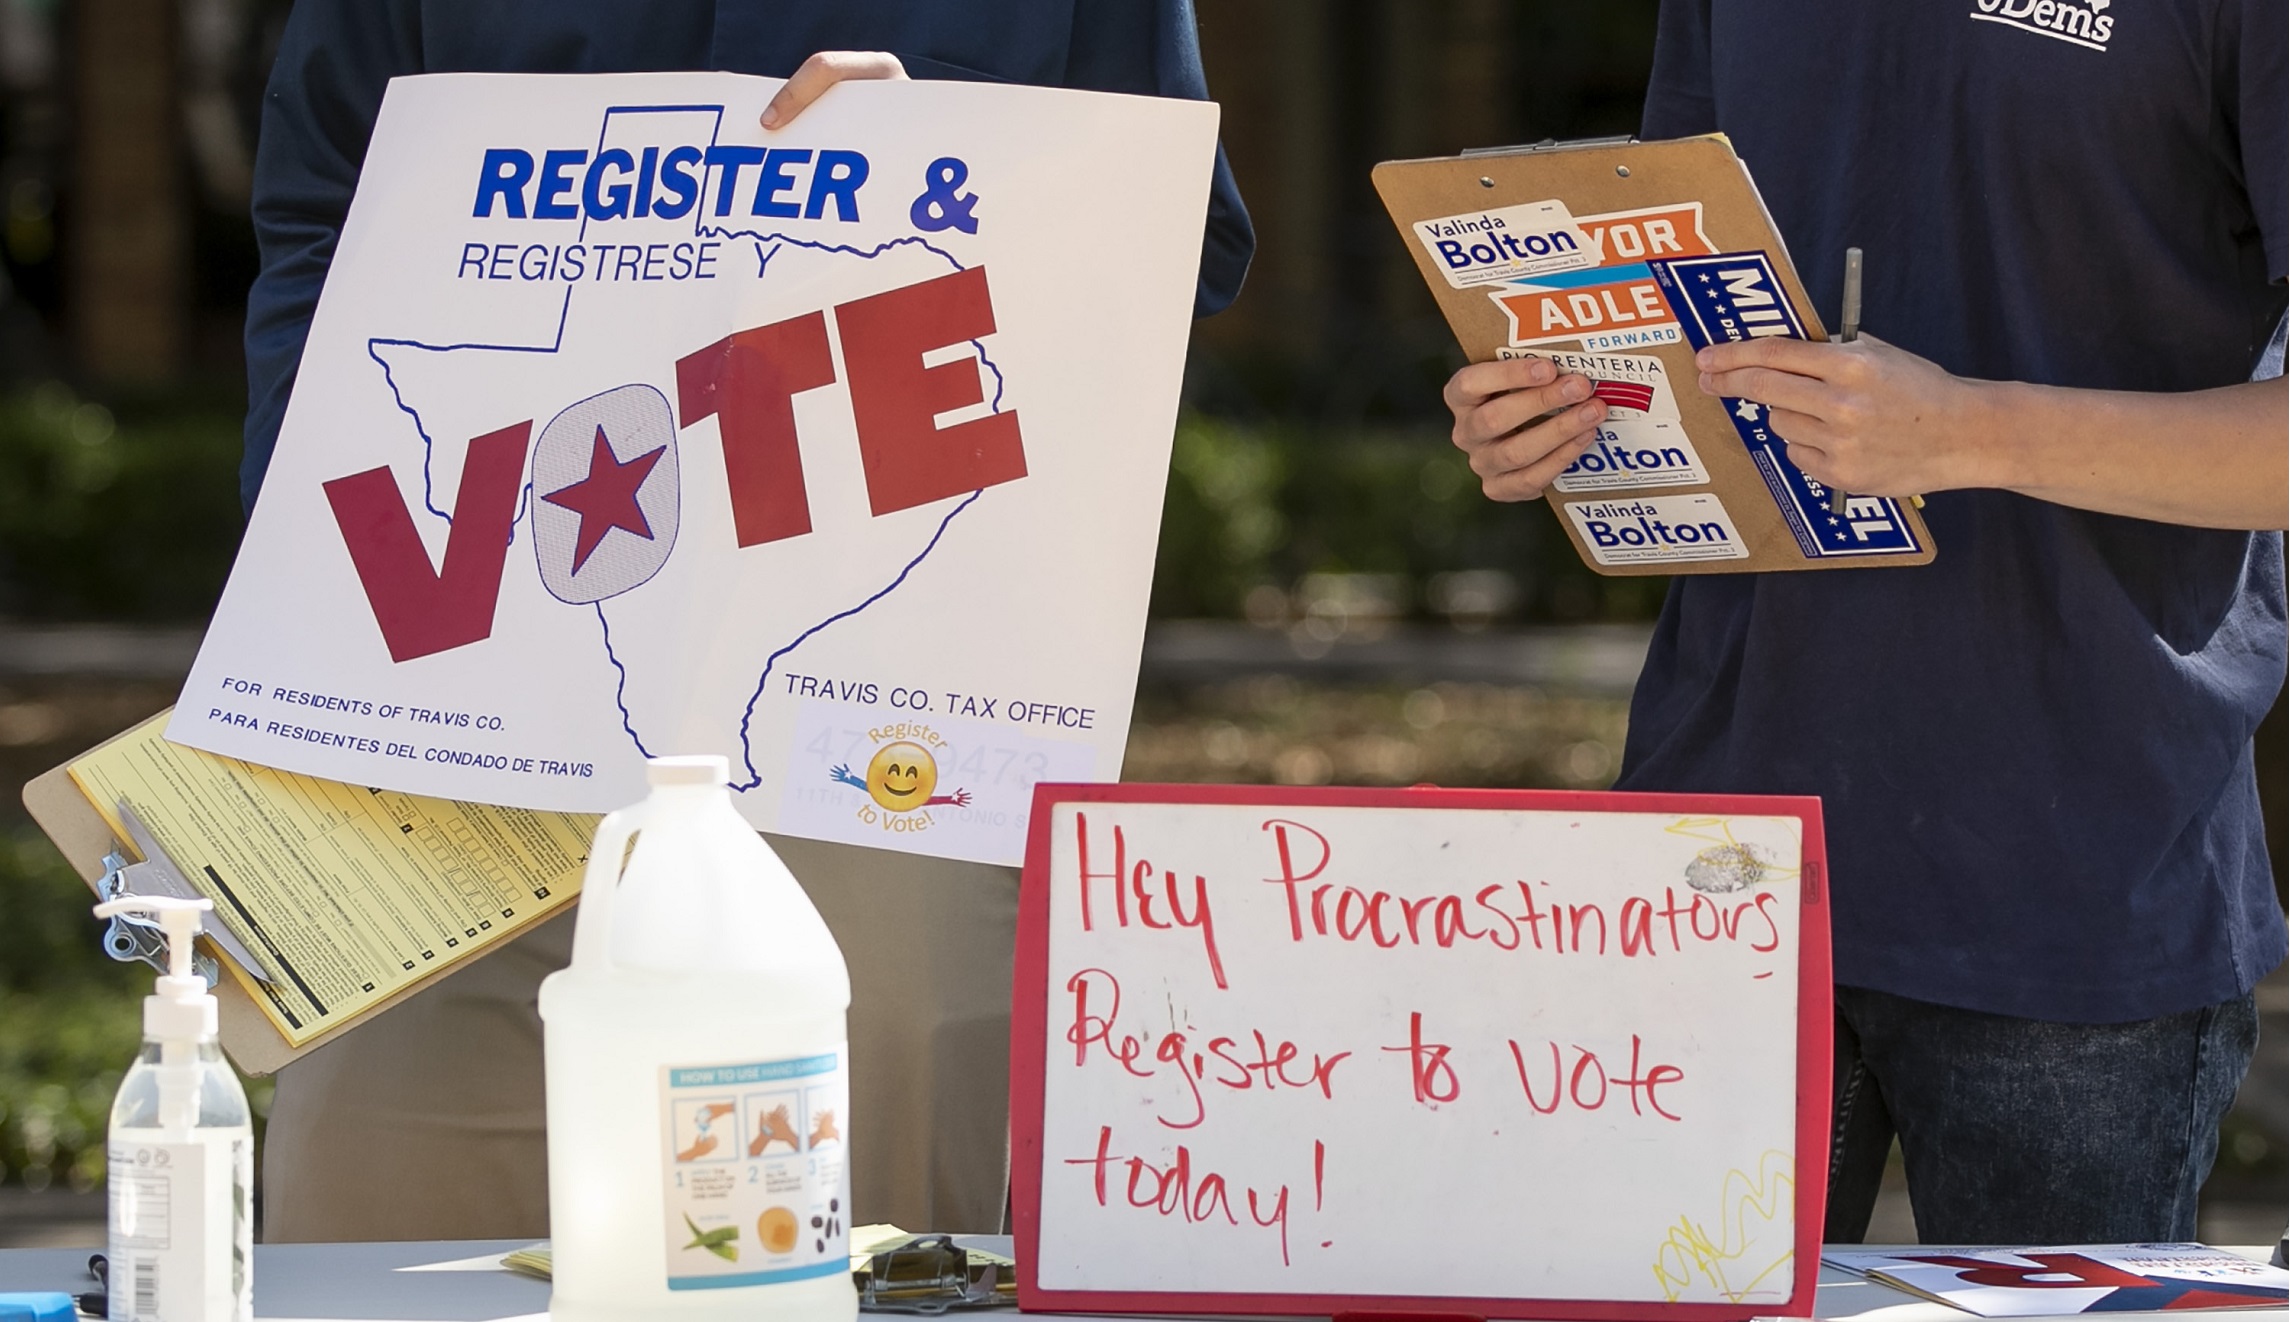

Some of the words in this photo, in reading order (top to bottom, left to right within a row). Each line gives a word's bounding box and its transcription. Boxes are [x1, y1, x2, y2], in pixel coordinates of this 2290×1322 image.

[472, 146, 869, 222] REGISTER
[910, 157, 979, 234] &
[1425, 215, 1506, 238] Valinda
[458, 242, 721, 282] REGISTRESE
[754, 242, 781, 278] Y
[1435, 231, 1578, 269] Bolton
[1540, 285, 1665, 331] ADLE
[1587, 329, 1677, 349] FORWARD
[1552, 355, 1662, 374] RENTERIA
[1753, 428, 1767, 441] 10
[321, 265, 1028, 663] VOTE
[1576, 502, 1657, 519] Valinda
[1585, 517, 1728, 547] Bolton
[222, 677, 262, 696] FOR
[273, 688, 373, 715] RESIDENTS
[379, 704, 403, 719] OF
[410, 708, 469, 730] TRAVIS
[476, 716, 505, 731] CO.
[785, 674, 879, 704] TRAVIS
[890, 688, 934, 712] CO.
[946, 694, 997, 719] TAX
[1008, 701, 1096, 729] OFFICE
[209, 708, 258, 731] PARA
[267, 722, 380, 754] RESIDENTES
[386, 743, 417, 759] DEL
[425, 748, 507, 771] CONDADO
[512, 757, 534, 773] DE
[539, 760, 594, 778] TRAVIS
[868, 720, 948, 749] Register
[857, 803, 877, 825] to
[883, 810, 935, 832] Vote!
[1076, 812, 1229, 990] Hey
[252, 925, 279, 956] Qualifications
[1066, 968, 1352, 1128] Register
[1382, 1012, 1461, 1103] to
[1063, 1126, 1334, 1267] today!
